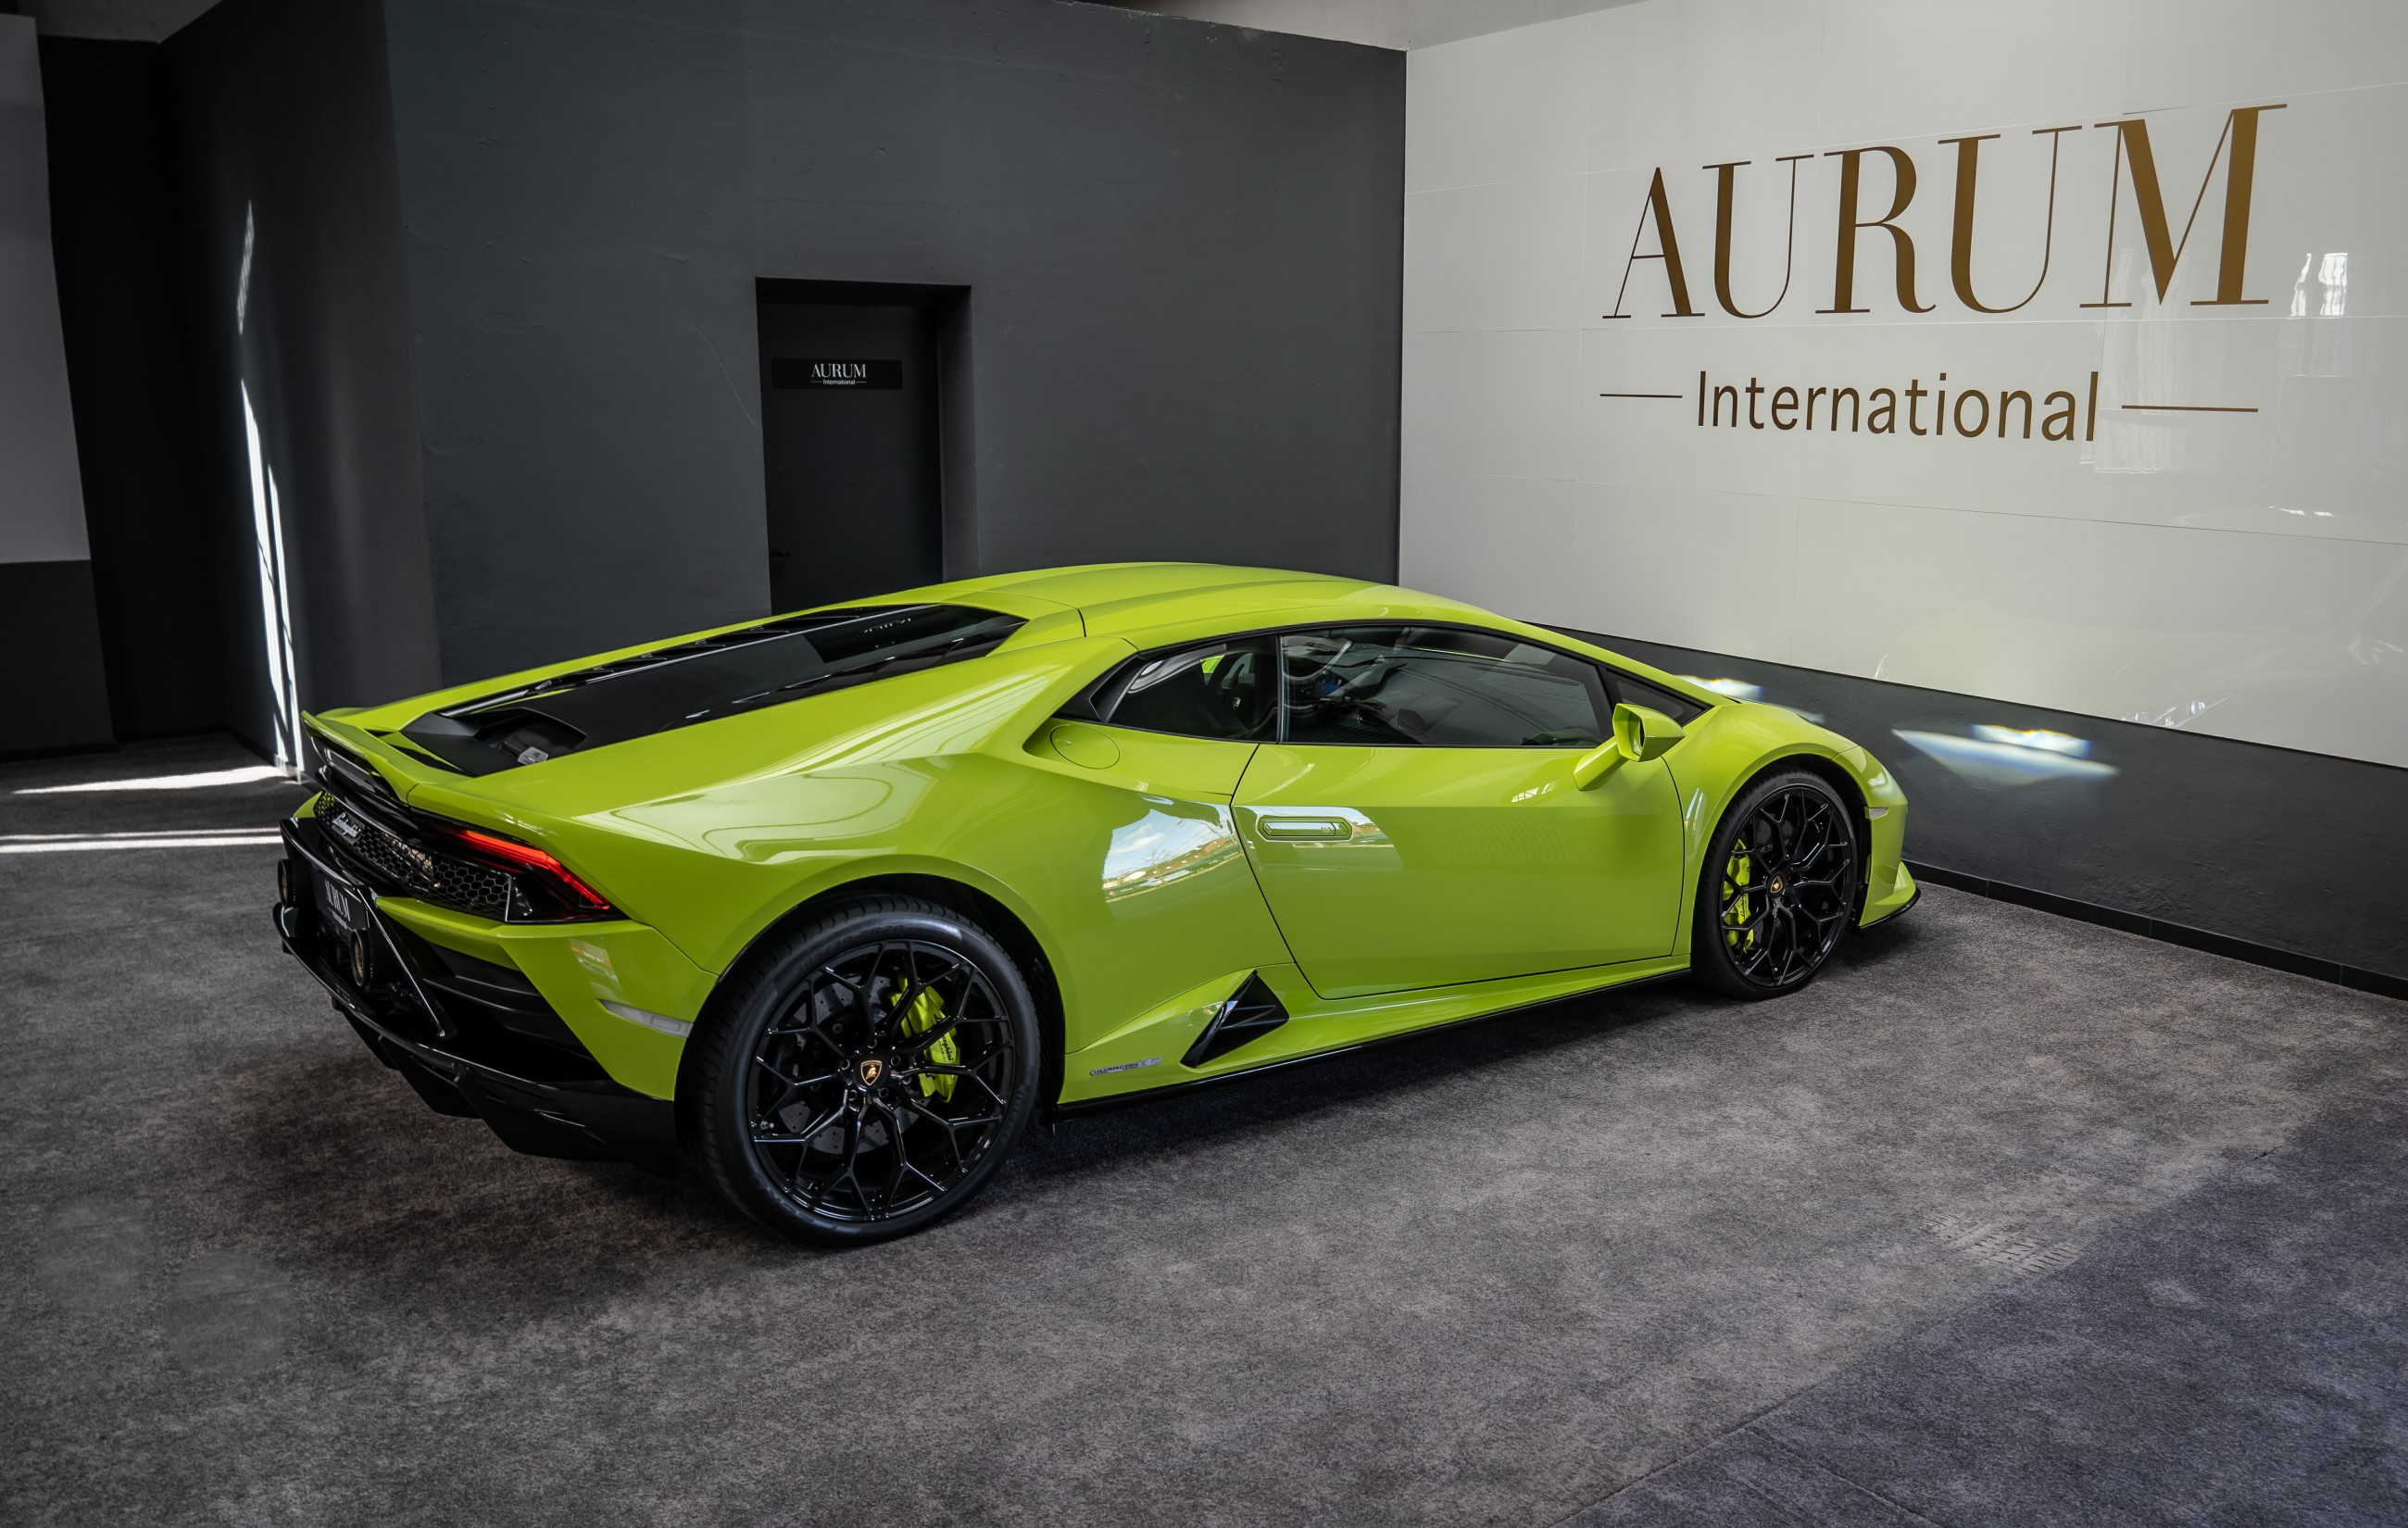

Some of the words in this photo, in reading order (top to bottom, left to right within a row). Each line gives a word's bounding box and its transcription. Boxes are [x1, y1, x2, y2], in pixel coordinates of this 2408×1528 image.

[1602, 103, 2288, 319] AURUM
[810, 363, 867, 378] AURUM
[1697, 370, 2099, 442] International
